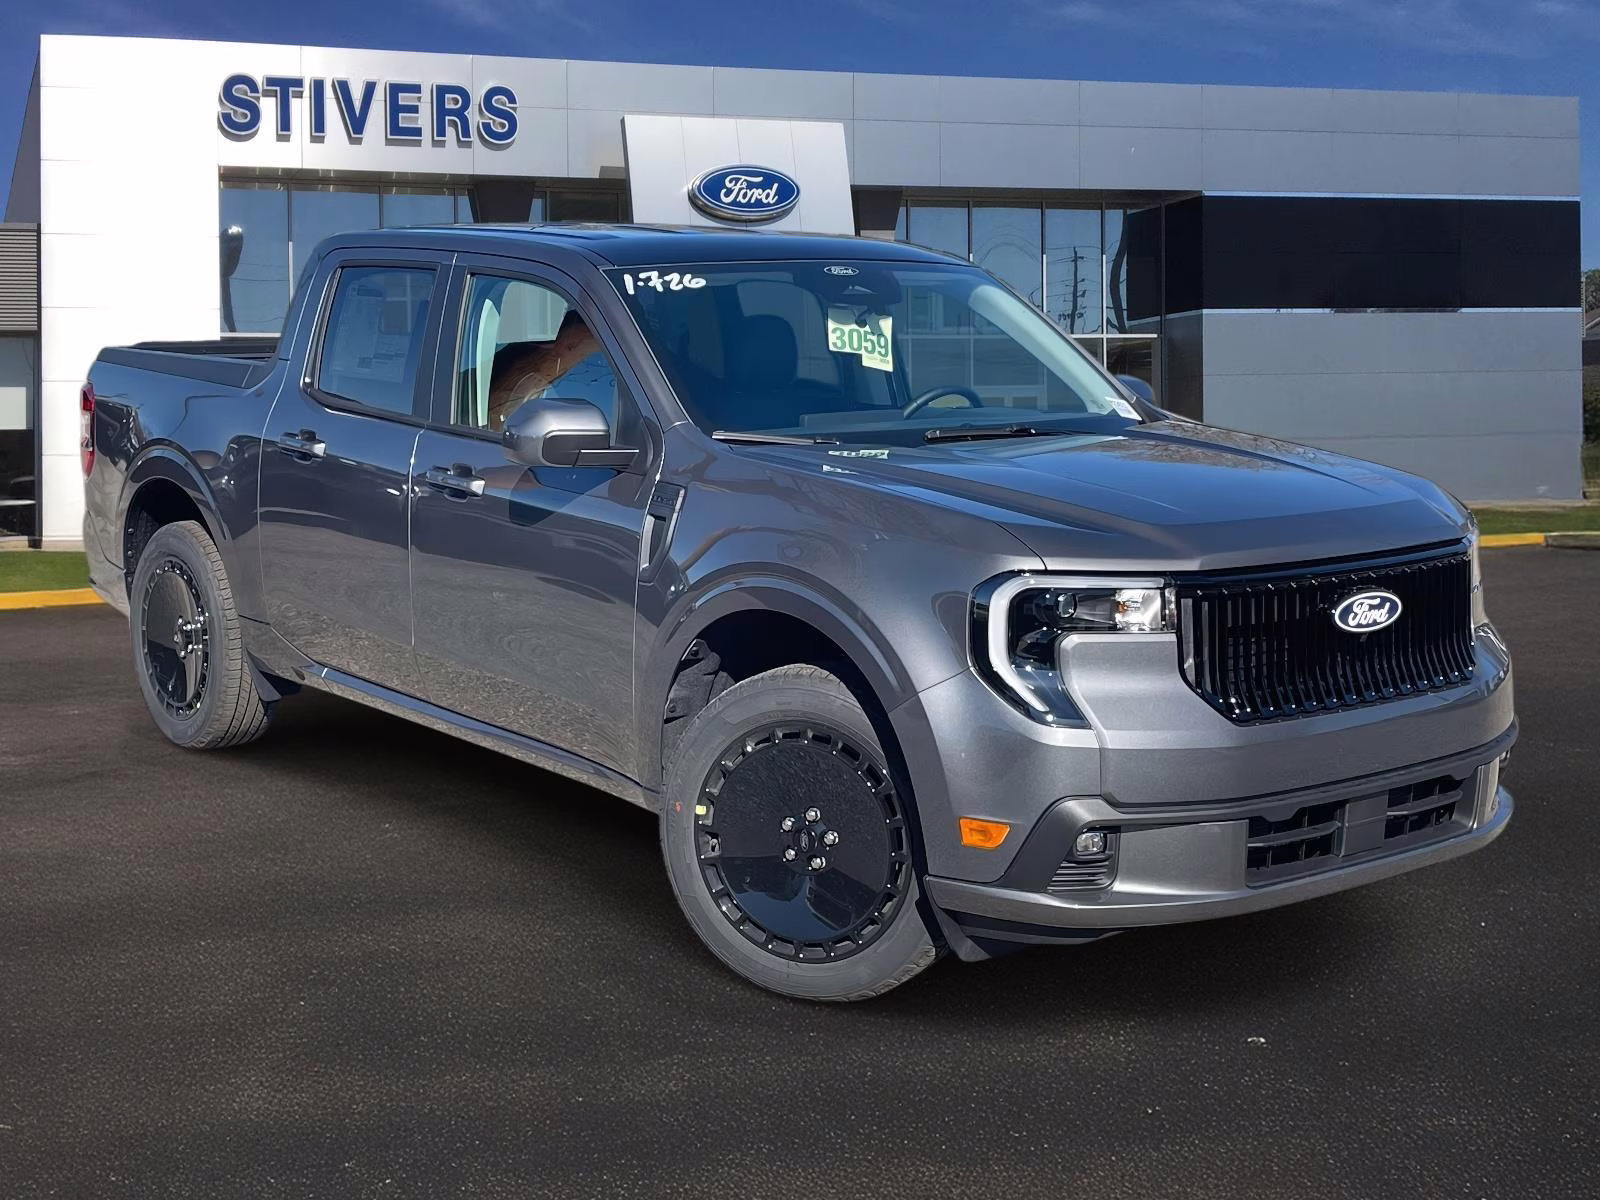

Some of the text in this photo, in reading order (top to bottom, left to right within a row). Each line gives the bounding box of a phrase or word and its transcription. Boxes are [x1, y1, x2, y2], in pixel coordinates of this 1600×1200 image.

[218, 72, 519, 148] STIVERS
[720, 174, 779, 204] Ford
[831, 326, 890, 358] 3059
[1347, 597, 1391, 627] Ford
